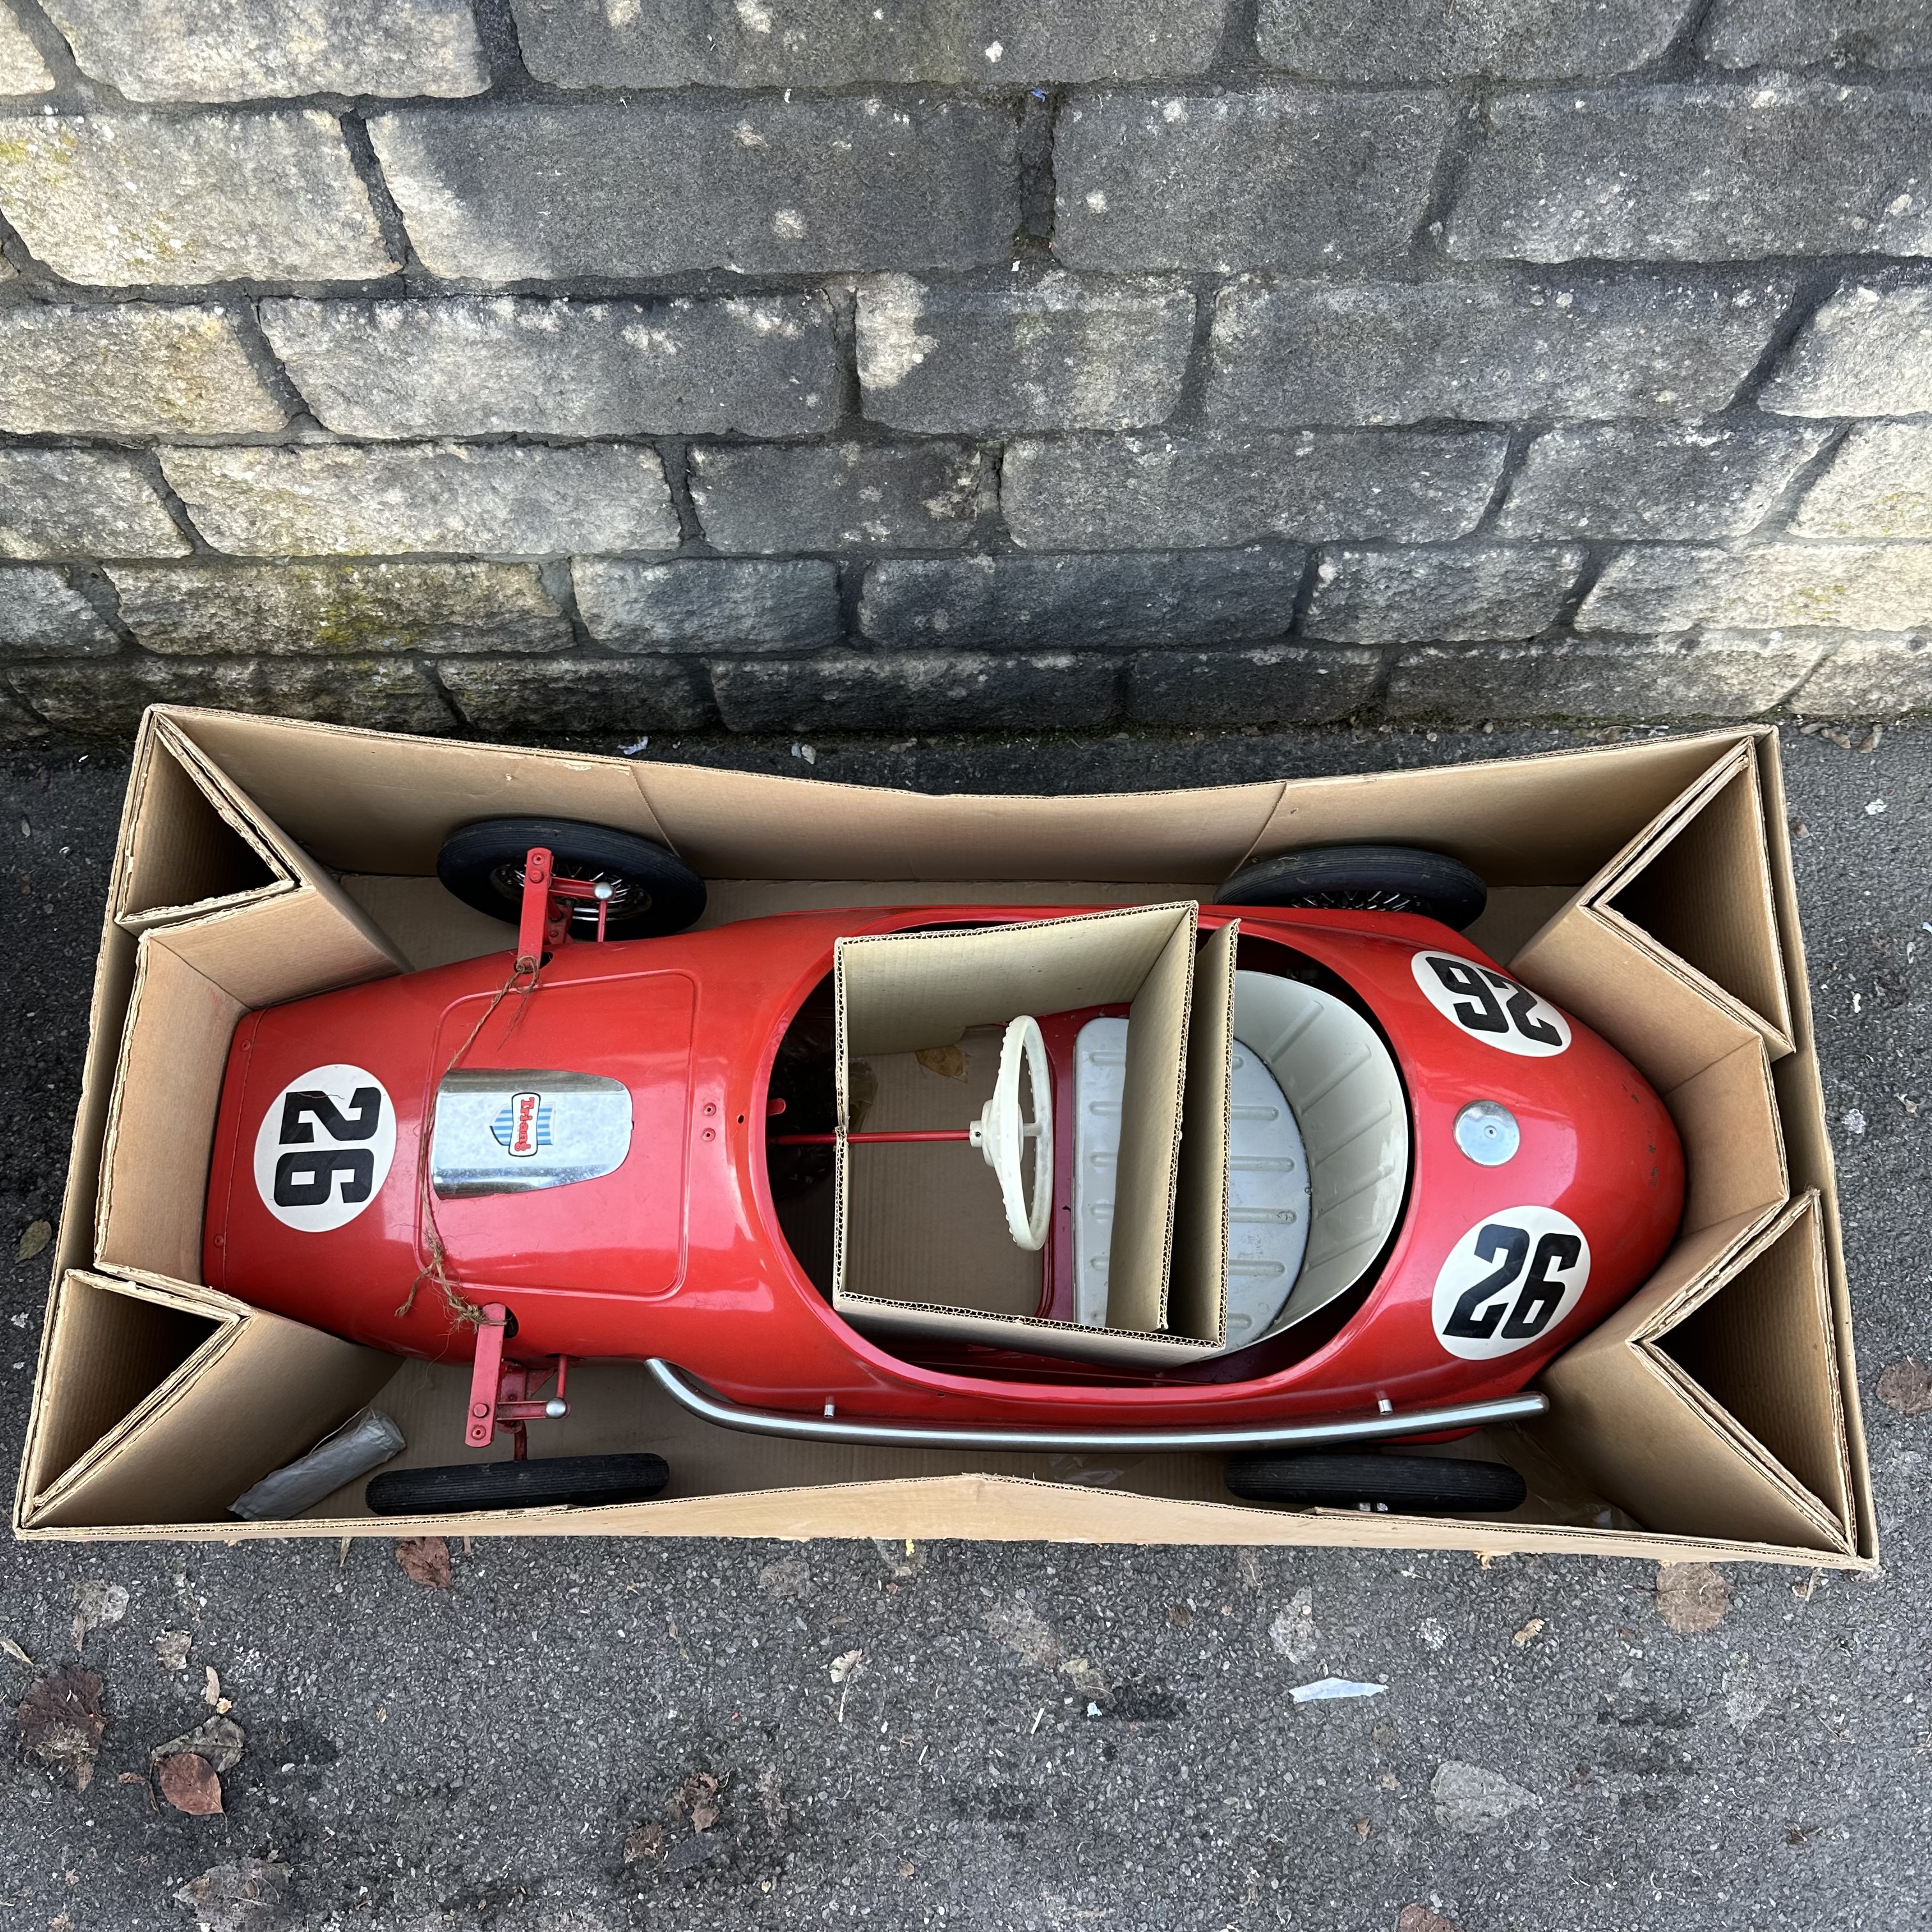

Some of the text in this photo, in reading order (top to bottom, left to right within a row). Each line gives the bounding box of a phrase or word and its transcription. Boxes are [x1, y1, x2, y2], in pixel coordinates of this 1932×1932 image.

[1425, 956, 1563, 1046] 26
[273, 1087, 381, 1207] 26
[1442, 1223, 1582, 1339] 26
